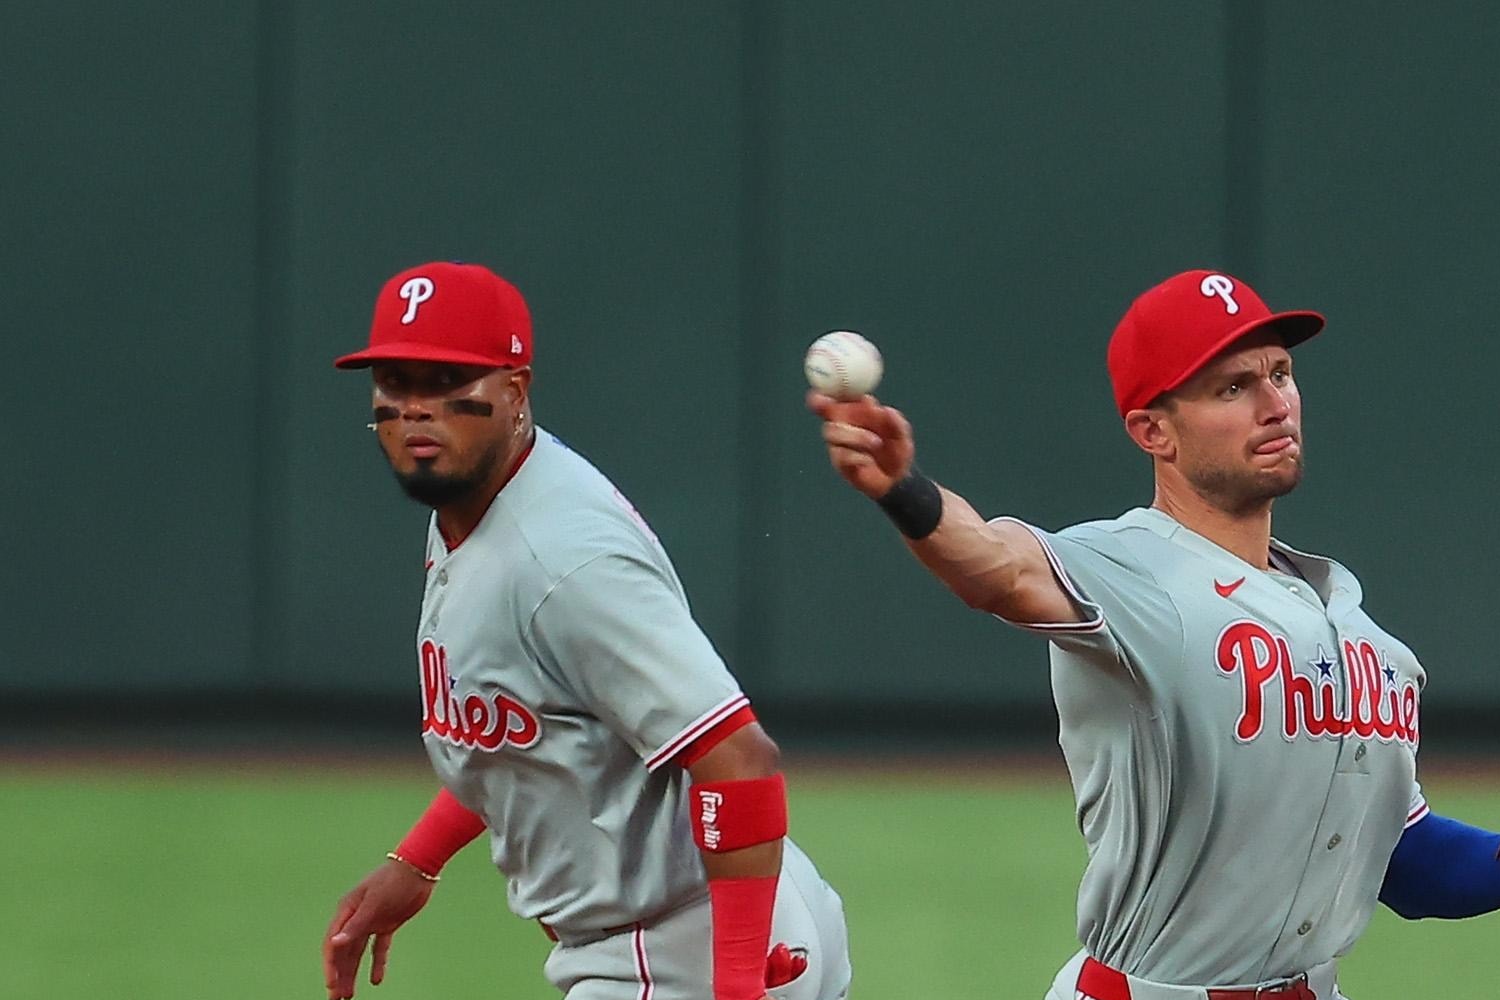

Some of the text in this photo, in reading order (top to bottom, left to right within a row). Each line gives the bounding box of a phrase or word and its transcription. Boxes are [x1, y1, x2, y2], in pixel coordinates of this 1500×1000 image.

[399, 276, 435, 325] P
[1200, 274, 1239, 315] P
[420, 638, 541, 752] llies
[1215, 618, 1420, 744] Phillie
